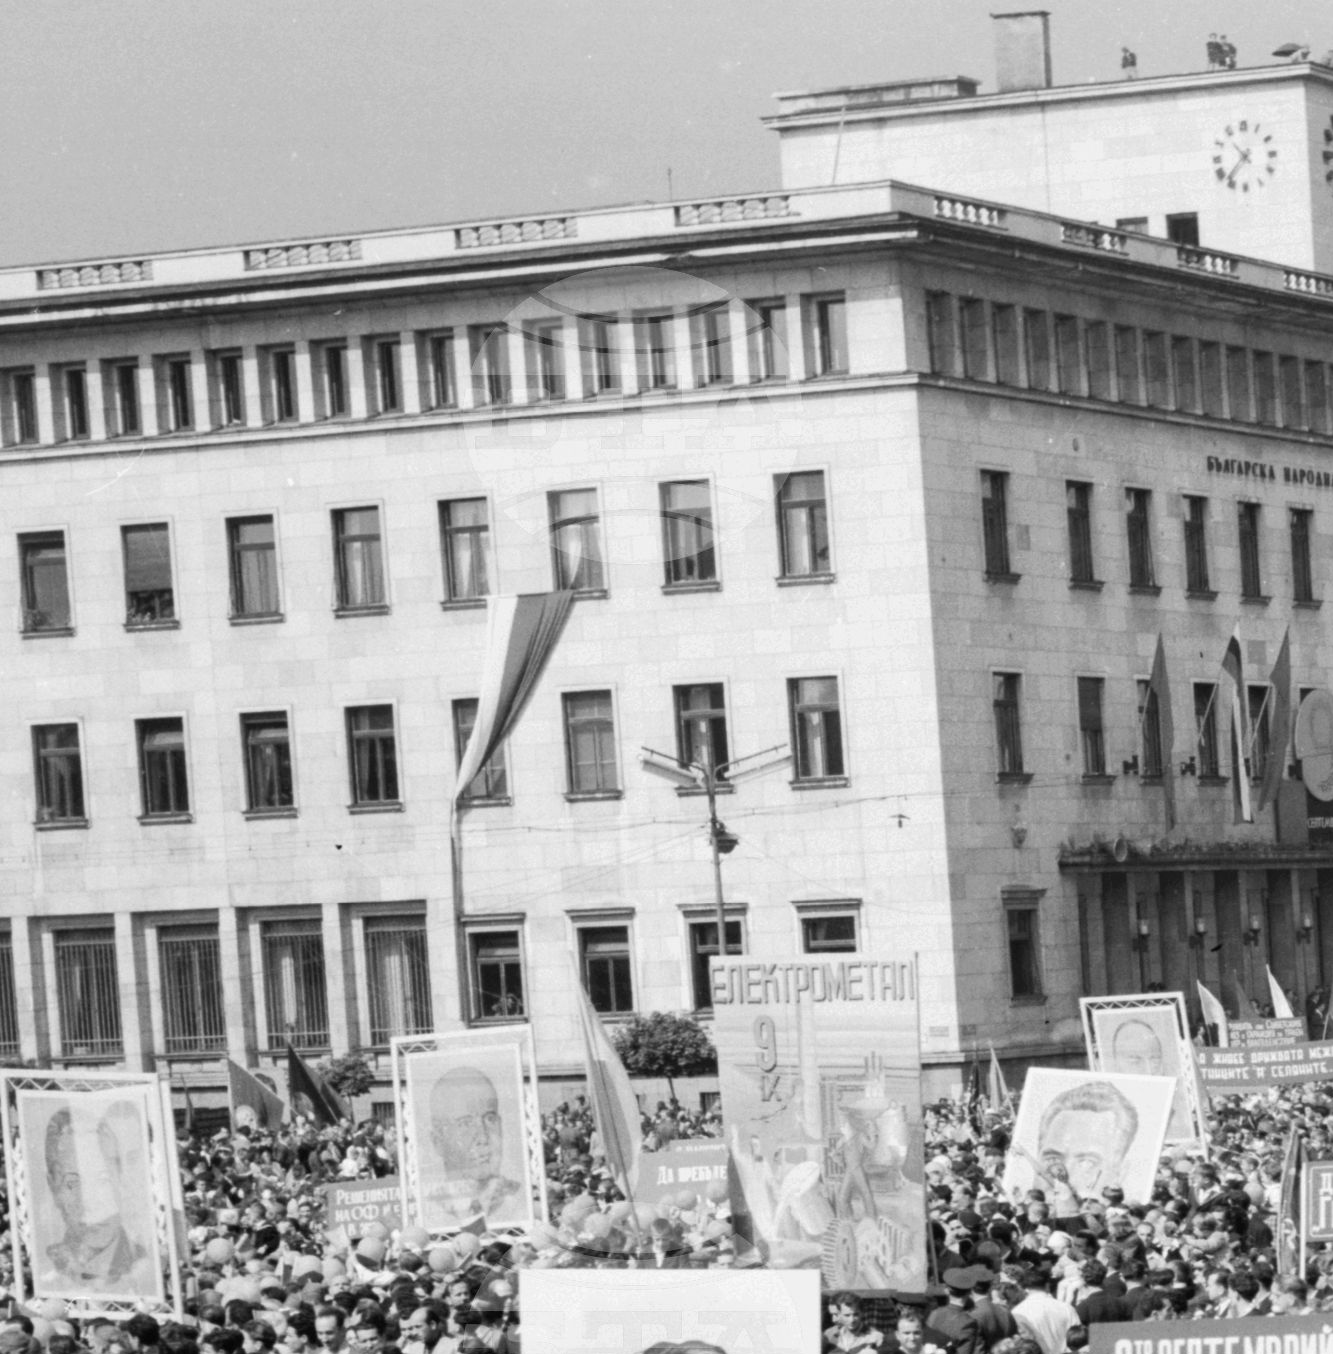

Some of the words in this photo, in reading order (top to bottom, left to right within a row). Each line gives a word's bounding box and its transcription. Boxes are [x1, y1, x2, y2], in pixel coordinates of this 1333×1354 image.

[1206, 455, 1276, 480] БЪЛГАРСКА
[711, 961, 915, 1005] ЕЛЕКТРОМЕТАЛ
[753, 1014, 777, 1073] 9
